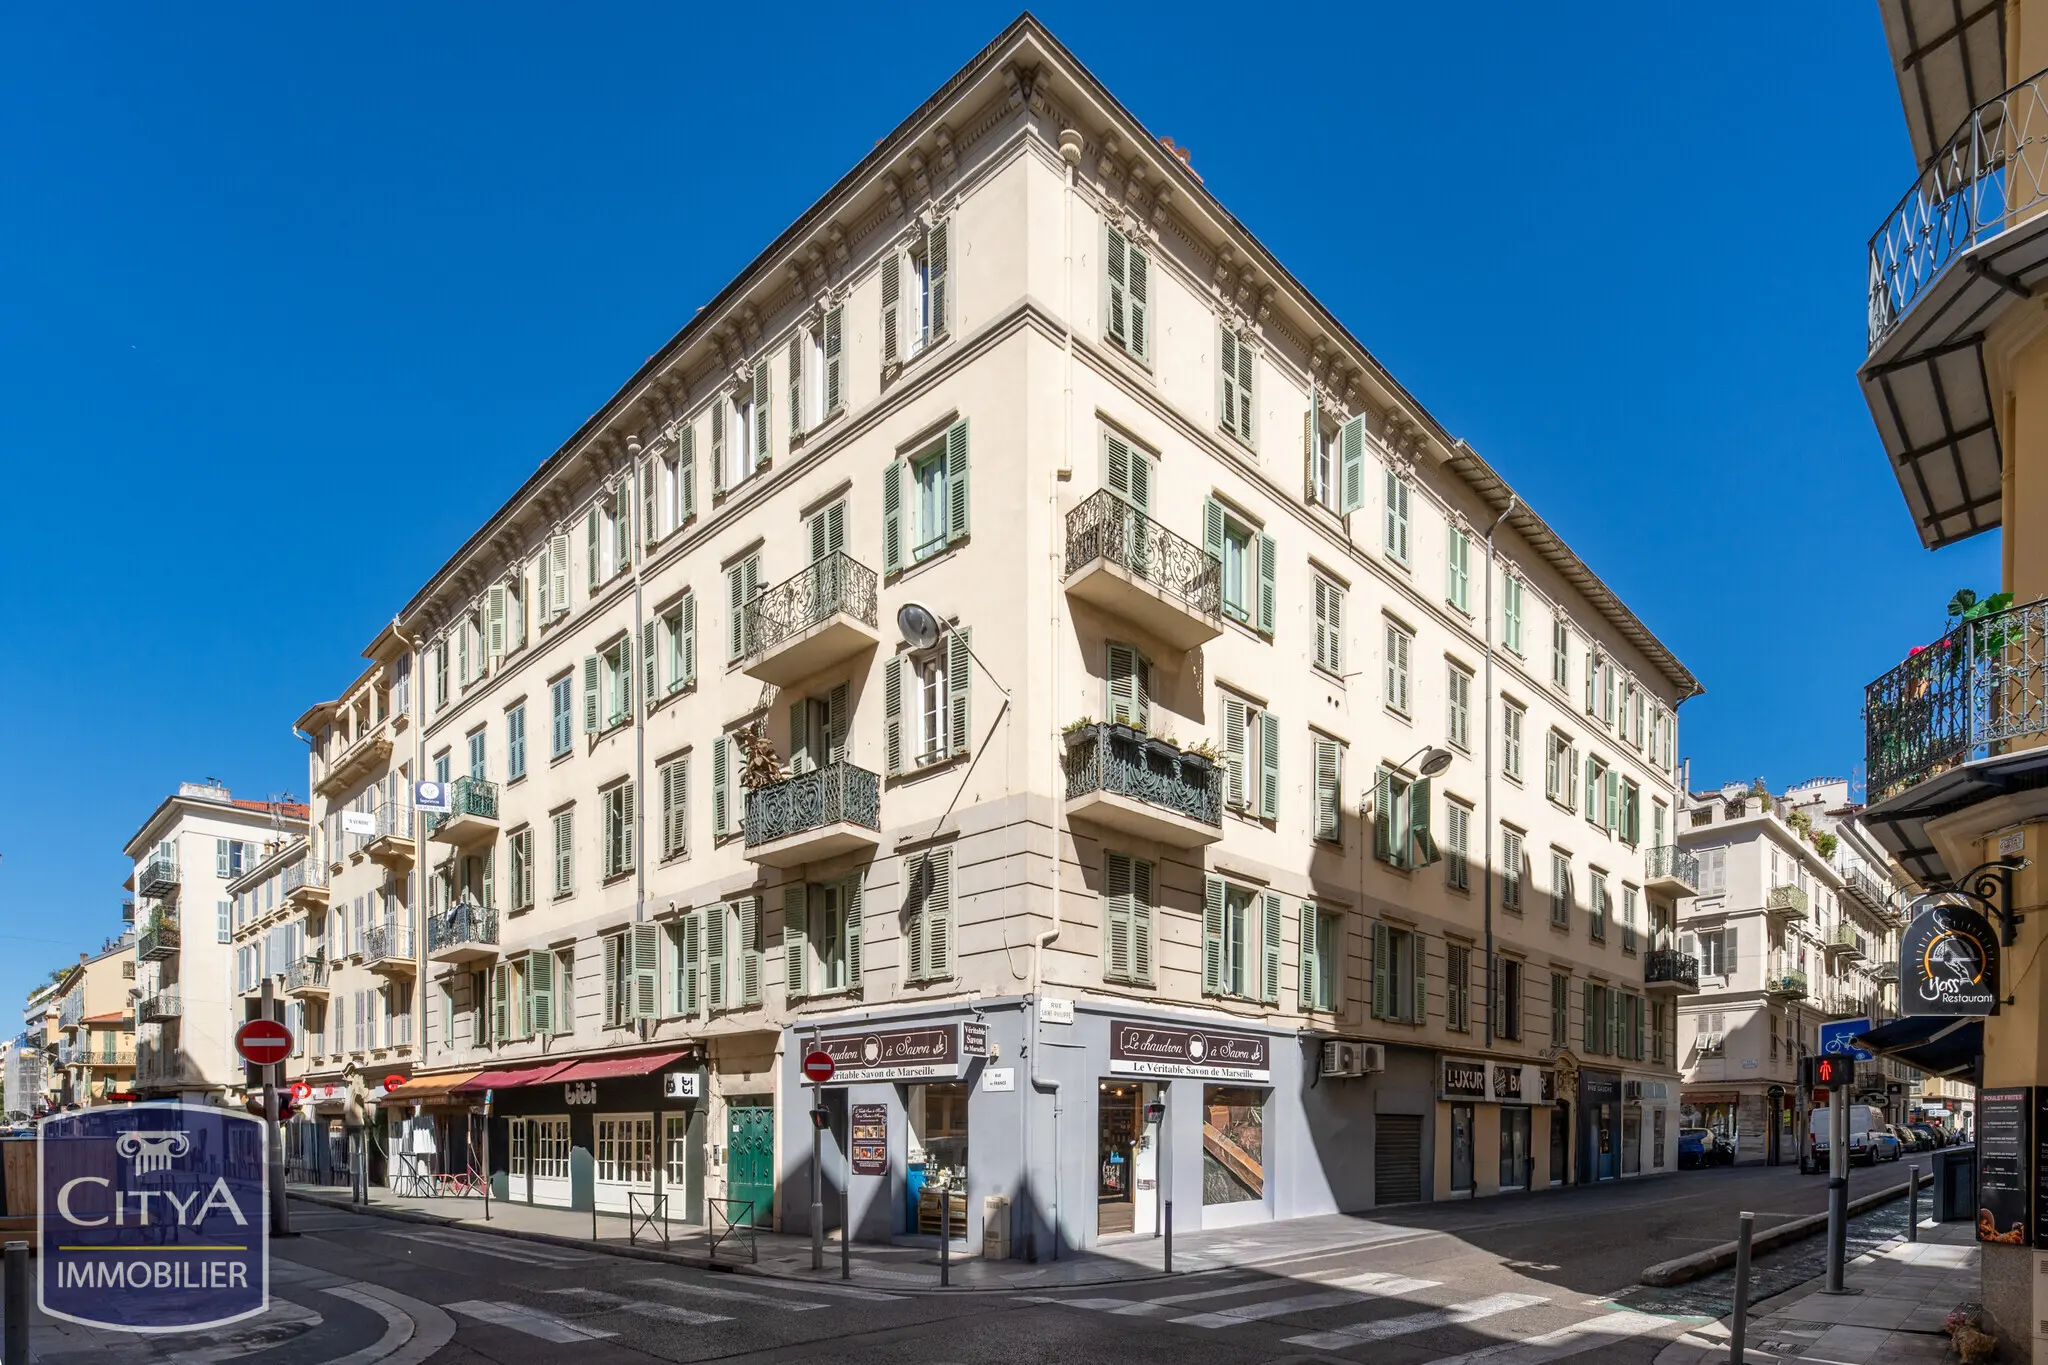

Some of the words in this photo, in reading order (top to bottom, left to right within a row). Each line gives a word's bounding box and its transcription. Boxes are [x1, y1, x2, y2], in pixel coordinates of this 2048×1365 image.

[1942, 993, 1993, 1003] Restaurant
[964, 1025, 986, 1036] Véritable
[885, 1046, 893, 1057] à
[895, 1036, 930, 1056] Savon
[966, 1034, 983, 1045] Savon
[1124, 1032, 1139, 1050] Le
[1140, 1034, 1183, 1054] chaudron
[1210, 1045, 1218, 1057] à
[1219, 1040, 1250, 1058] Savon
[969, 1044, 986, 1053] Marseille
[860, 1066, 884, 1079] Savon
[885, 1066, 895, 1077] de
[897, 1066, 935, 1077] Marseille
[1133, 1062, 1145, 1072] Le
[1147, 1062, 1184, 1074] Véritable
[1185, 1066, 1209, 1076] Savon
[1210, 1066, 1219, 1076] de
[1221, 1068, 1254, 1079] Marseille
[1448, 1069, 1486, 1090] LUXUR
[565, 1081, 599, 1105] bibi
